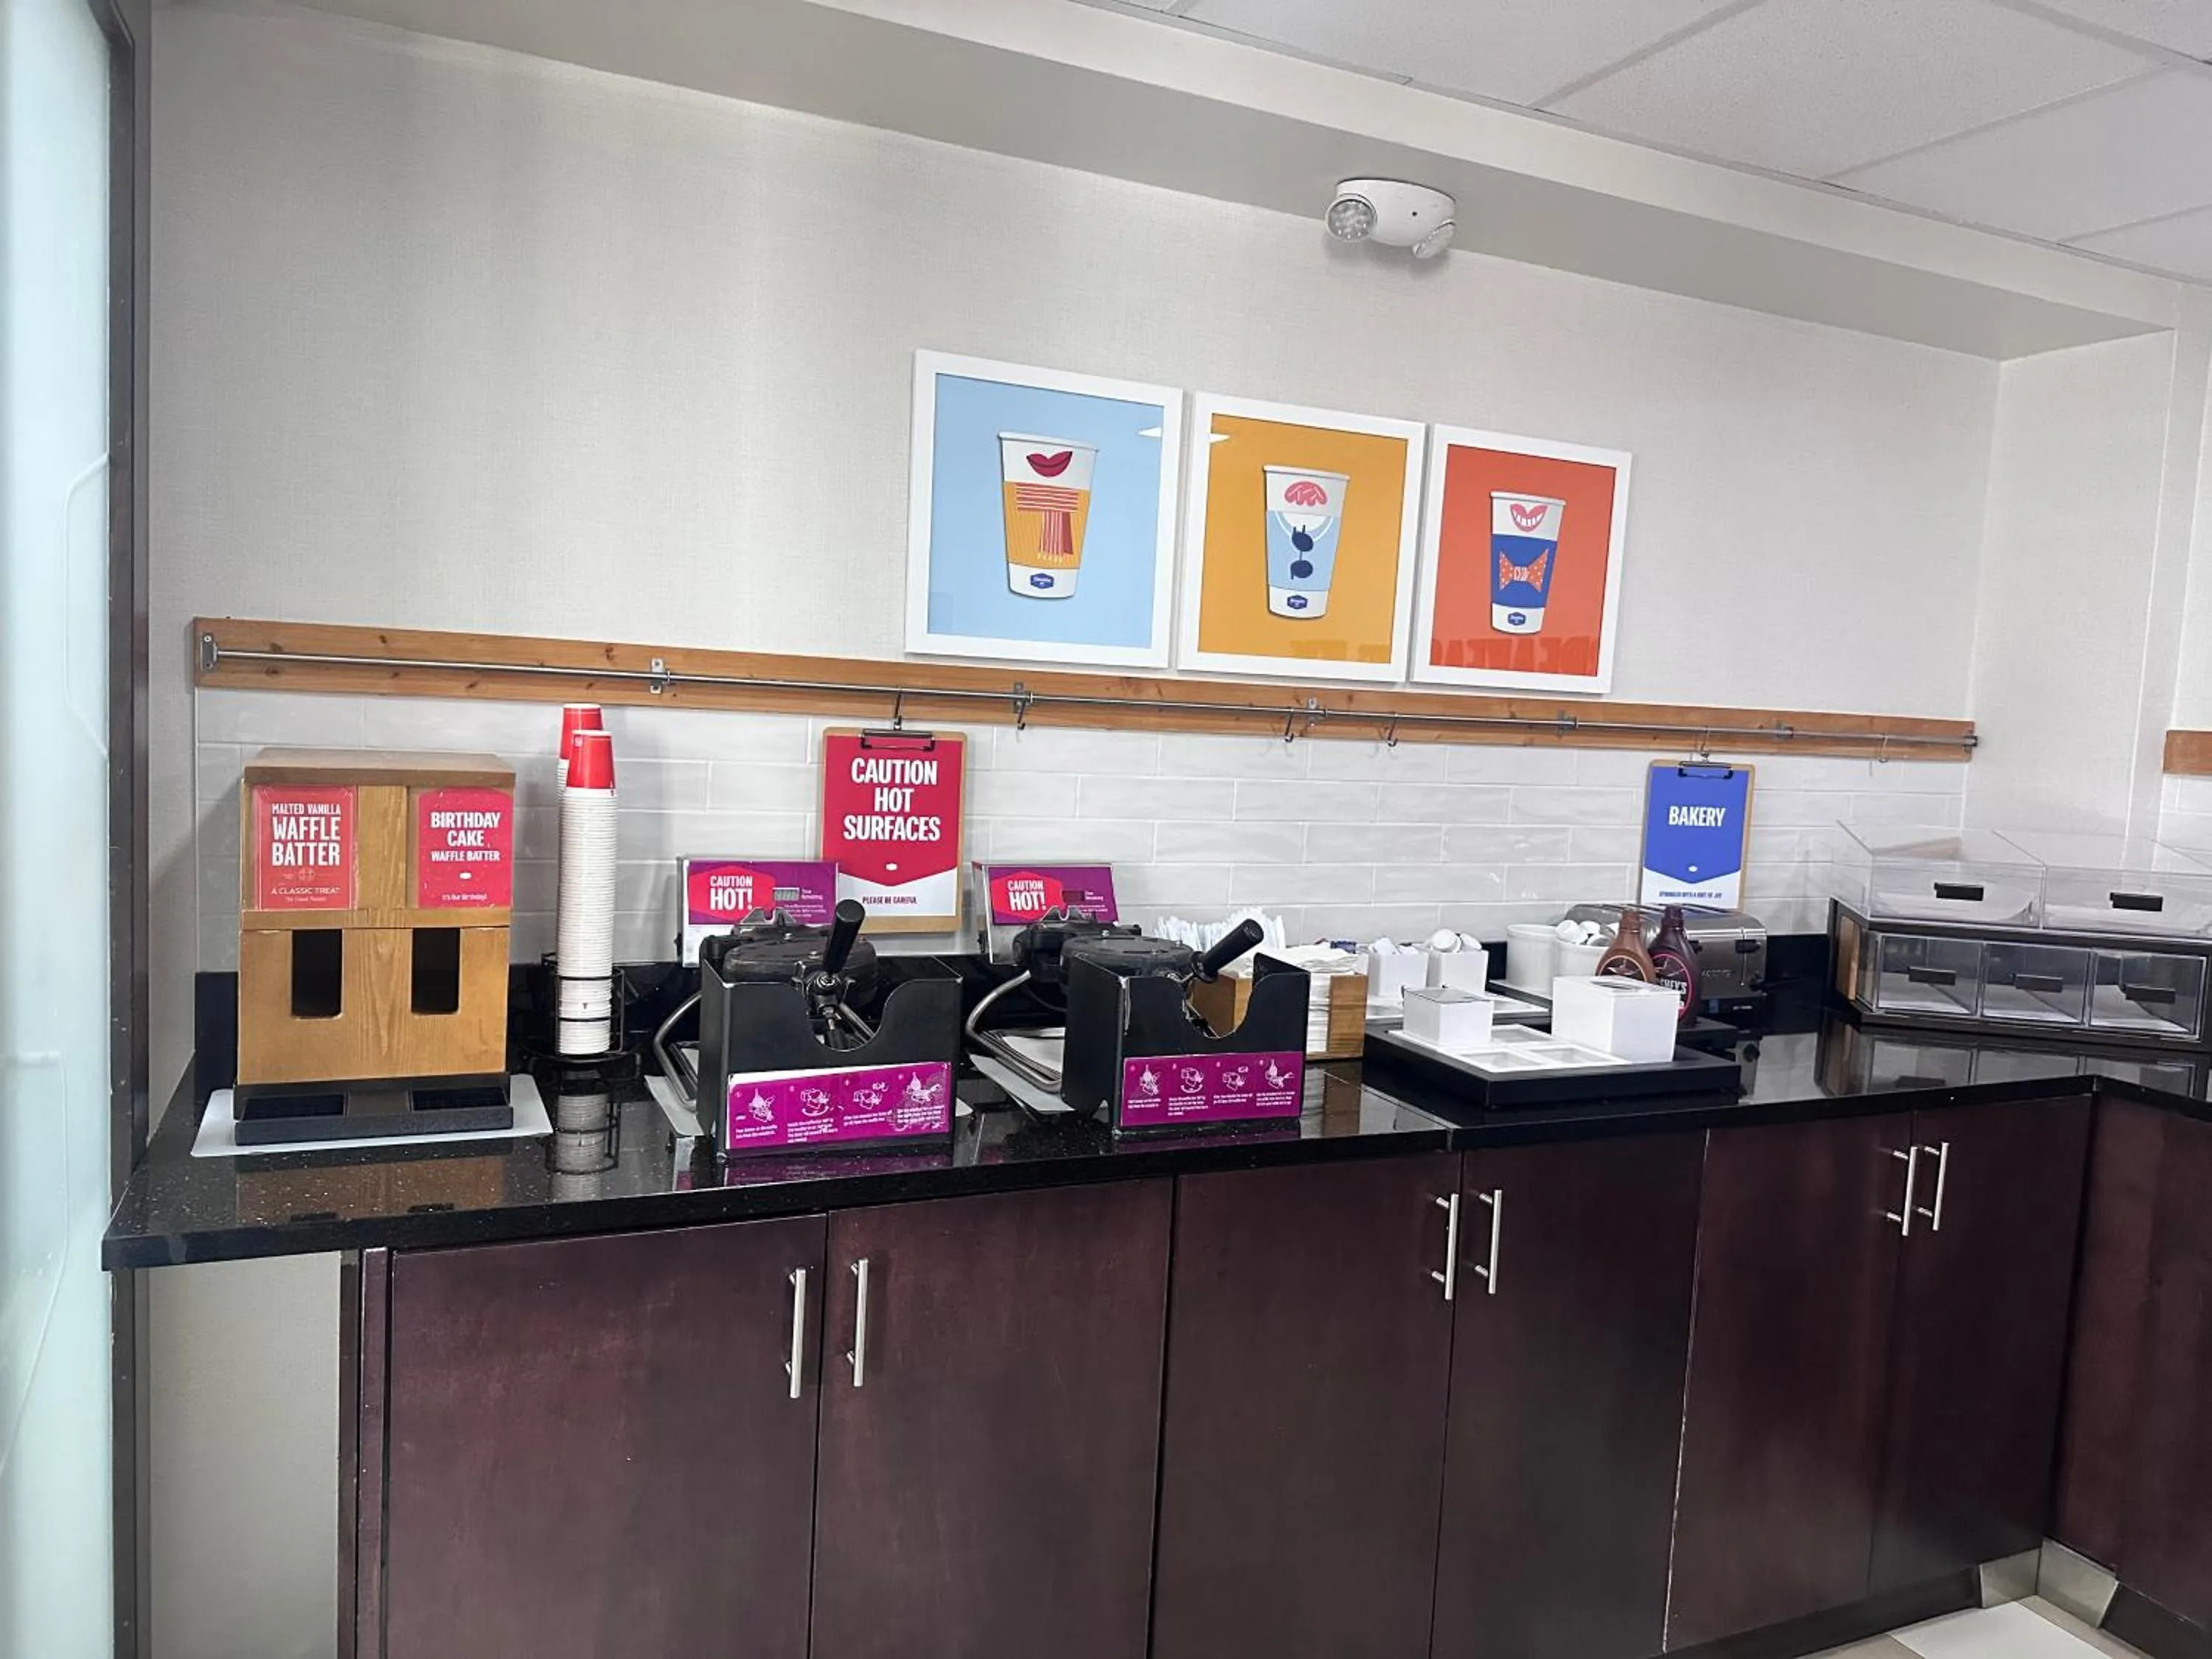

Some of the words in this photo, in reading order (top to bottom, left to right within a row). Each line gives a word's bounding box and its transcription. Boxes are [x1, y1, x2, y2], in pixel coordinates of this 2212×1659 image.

[851, 757, 938, 785] CAUTION
[271, 803, 305, 815] MALTED
[307, 803, 341, 815] VANILLA
[874, 787, 915, 813] HOT
[430, 812, 501, 828] BIRTHDAY
[1668, 805, 1726, 827] BAKERY
[271, 816, 341, 841] WAFFLE
[843, 815, 942, 841] SURFACES
[447, 830, 485, 847] CAKE
[271, 841, 341, 866] BATTER
[431, 850, 465, 862] WAFFLE
[466, 850, 501, 862] BATTER
[709, 875, 754, 888] CAUTION
[1007, 880, 1045, 891] CAUTION
[709, 888, 754, 911] HOT!
[862, 896, 884, 905] PLEASE
[884, 896, 892, 905] BE
[1009, 891, 1048, 911] HOT!
